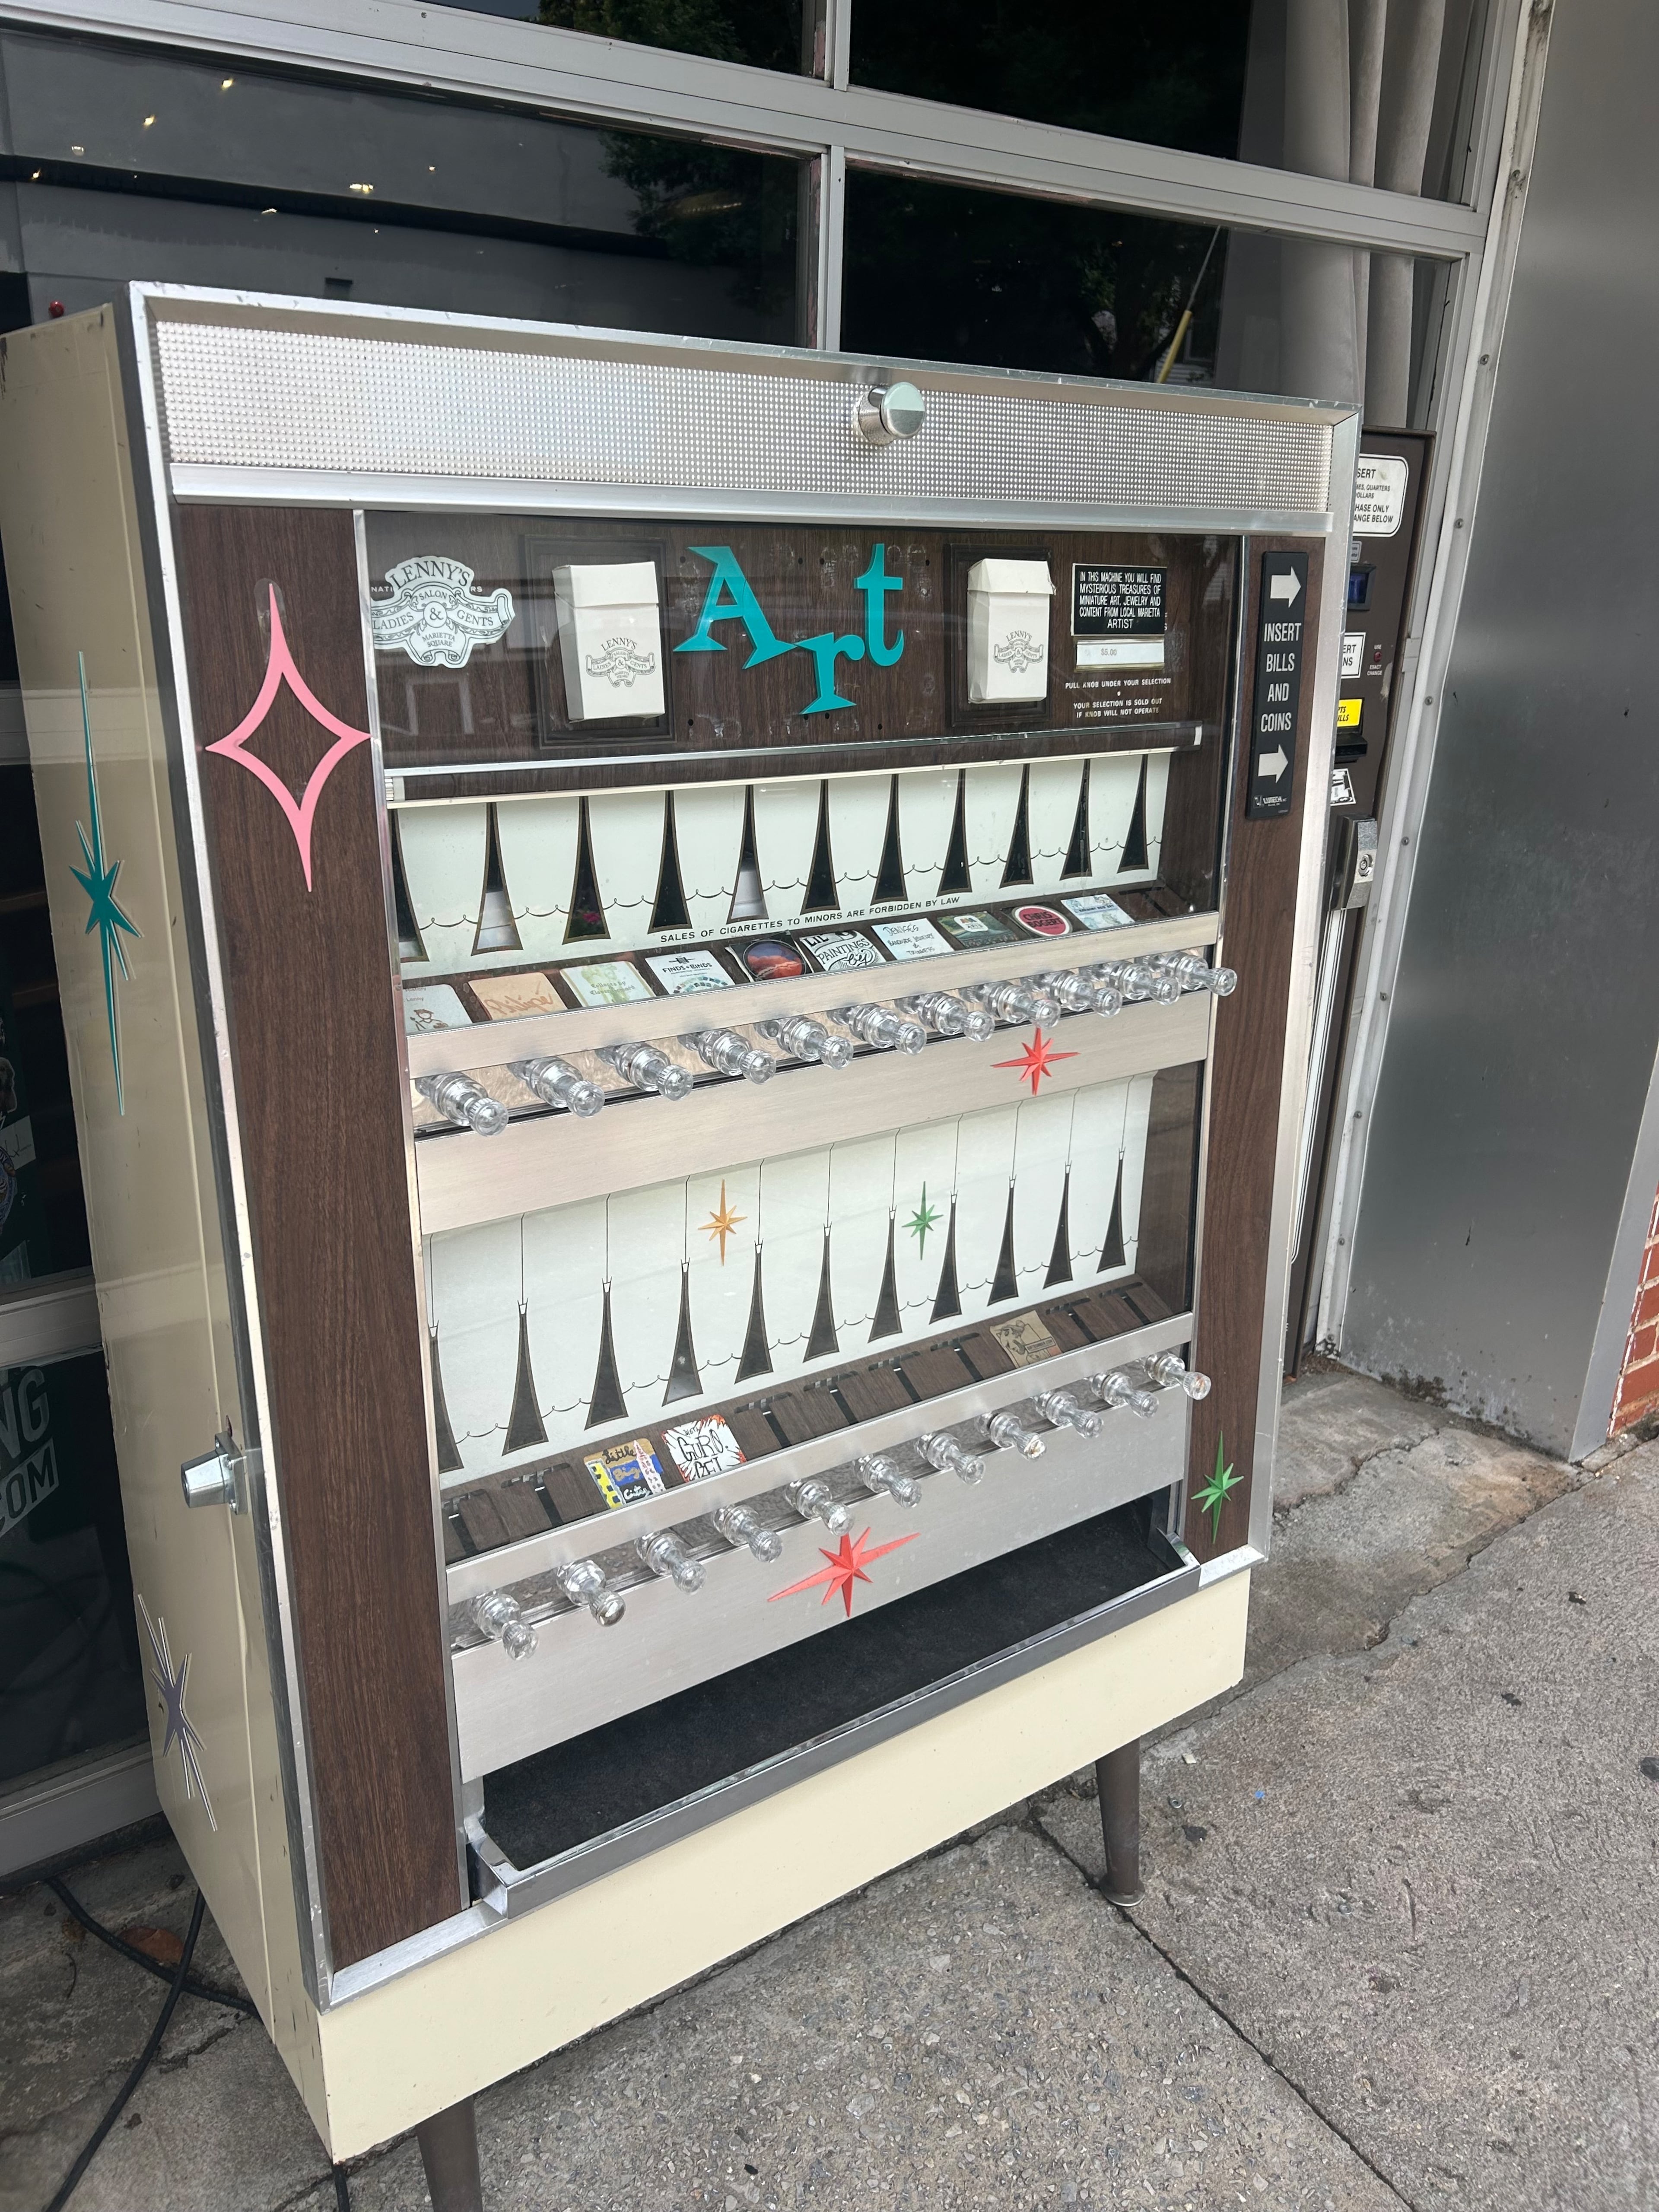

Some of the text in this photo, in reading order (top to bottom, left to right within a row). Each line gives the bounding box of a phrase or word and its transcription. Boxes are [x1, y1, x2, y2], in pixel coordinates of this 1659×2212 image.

[1357, 468, 1376, 479] SERT
[1354, 504, 1371, 512] HASE
[389, 560, 470, 590] LENNY'S
[1080, 571, 1162, 583] IN THIS MACHINE YOU WILL FIND
[1080, 583, 1161, 594] MYSTERIOUS TREASURES OF
[419, 590, 448, 601] SALON
[1080, 595, 1108, 605] MINIATURE
[1123, 596, 1148, 606] JEWELRY
[1149, 596, 1161, 606] AND
[1079, 607, 1103, 617] CONTENT
[1104, 607, 1118, 617] FROM
[1120, 607, 1135, 617] LOCAL
[1137, 607, 1160, 617] MARIETTA
[373, 607, 494, 629] LADIES & GENTS
[1107, 618, 1134, 629] ARTIST
[673, 543, 904, 715] Art
[1264, 623, 1301, 642] INSERT
[422, 632, 455, 642] MARIETTA
[427, 639, 453, 648] SQUARE
[1343, 645, 1357, 653] ERT
[593, 661, 611, 670] LADIES
[630, 660, 647, 669] GENTS
[1266, 653, 1295, 672] BILLS
[1141, 677, 1171, 686] SELECTION
[1267, 683, 1290, 702] AND
[1092, 700, 1124, 708] SELECTION
[1260, 712, 1292, 732] COINS
[661, 931, 695, 943] SALES
[700, 929, 715, 938] OF
[720, 920, 783, 935] CIGARETTES
[805, 912, 842, 924] MINORS
[846, 909, 865, 918] ARE
[869, 902, 922, 915] FORBIDDEN
[941, 896, 960, 905] LAW
[1023, 912, 1052, 920] CHRIS
[816, 938, 870, 965] PAINTINGS
[602, 1446, 637, 1465] Little
[623, 1485, 651, 1500] City
